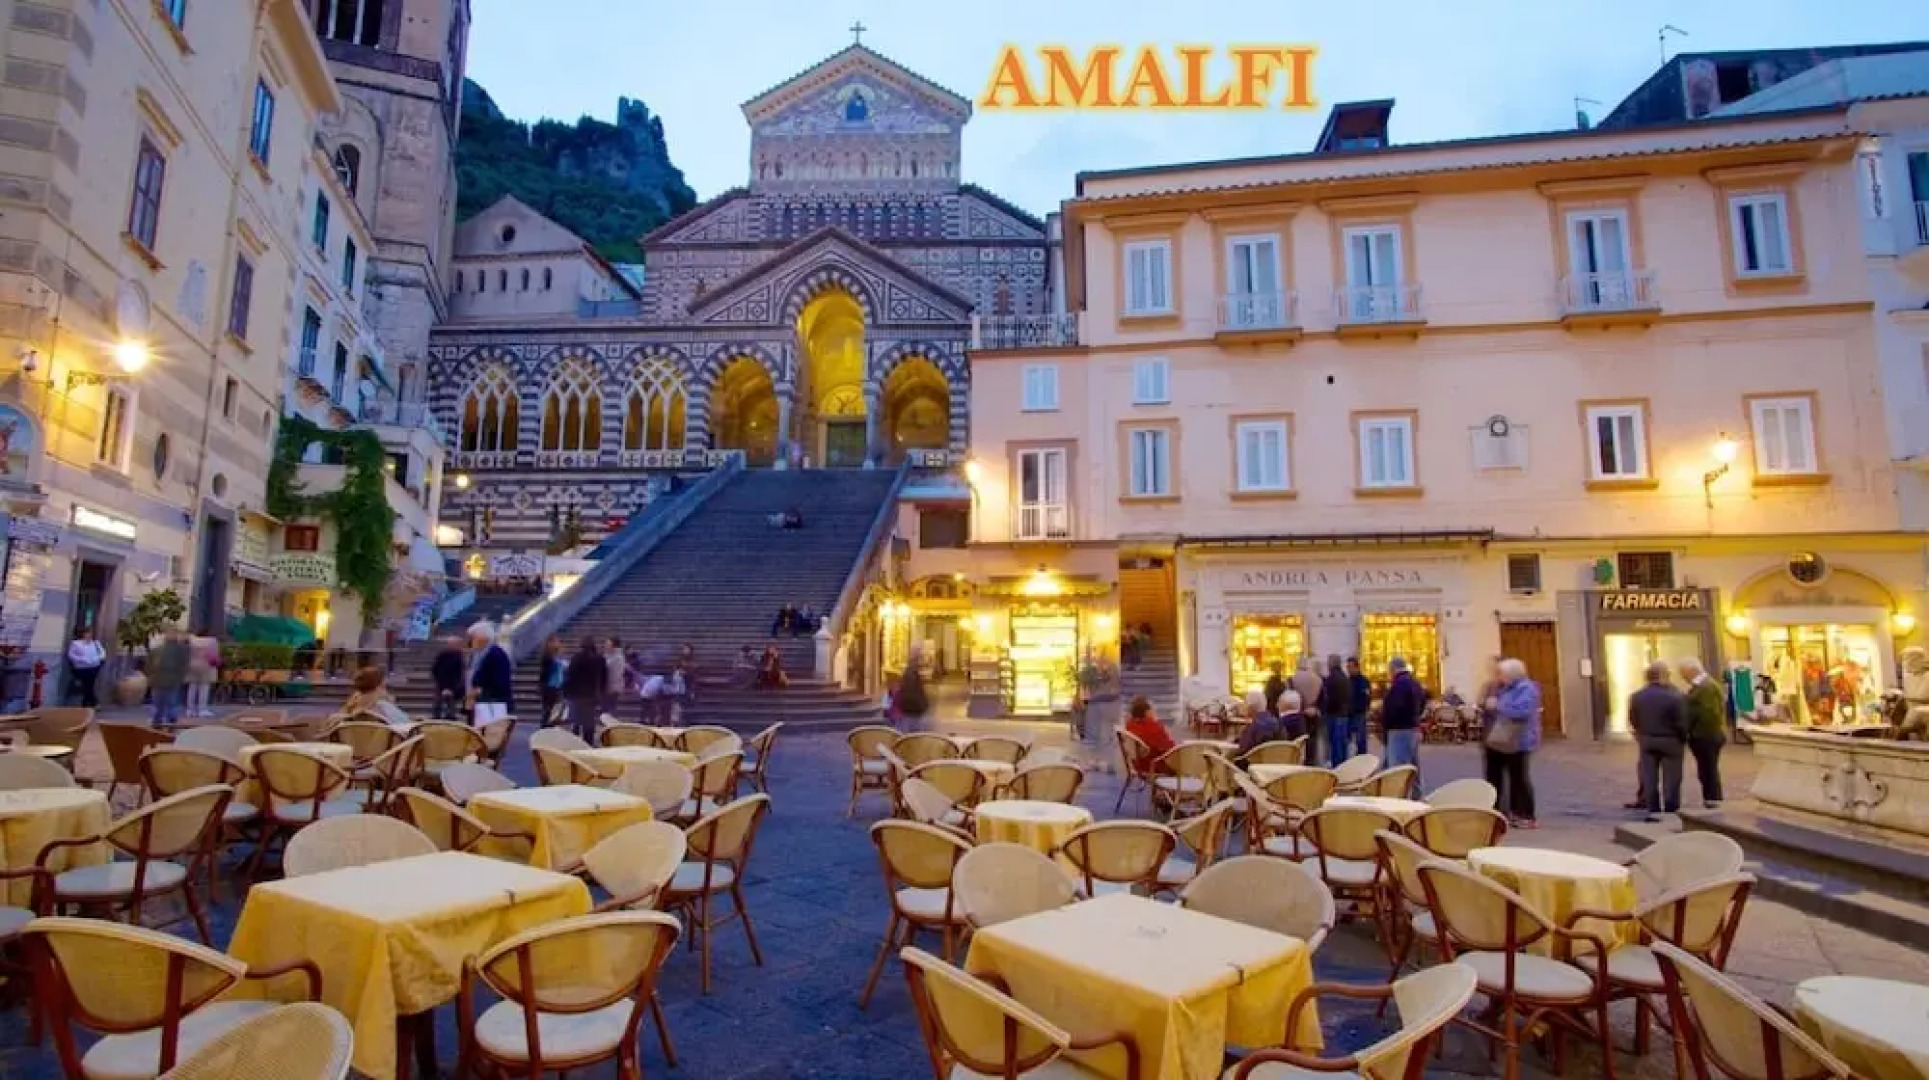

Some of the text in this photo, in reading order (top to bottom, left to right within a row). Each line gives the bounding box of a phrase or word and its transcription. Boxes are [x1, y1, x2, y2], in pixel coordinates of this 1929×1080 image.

[1242, 570, 1422, 585] ANDREA PANSA
[1602, 593, 1700, 610] FARMACIA
